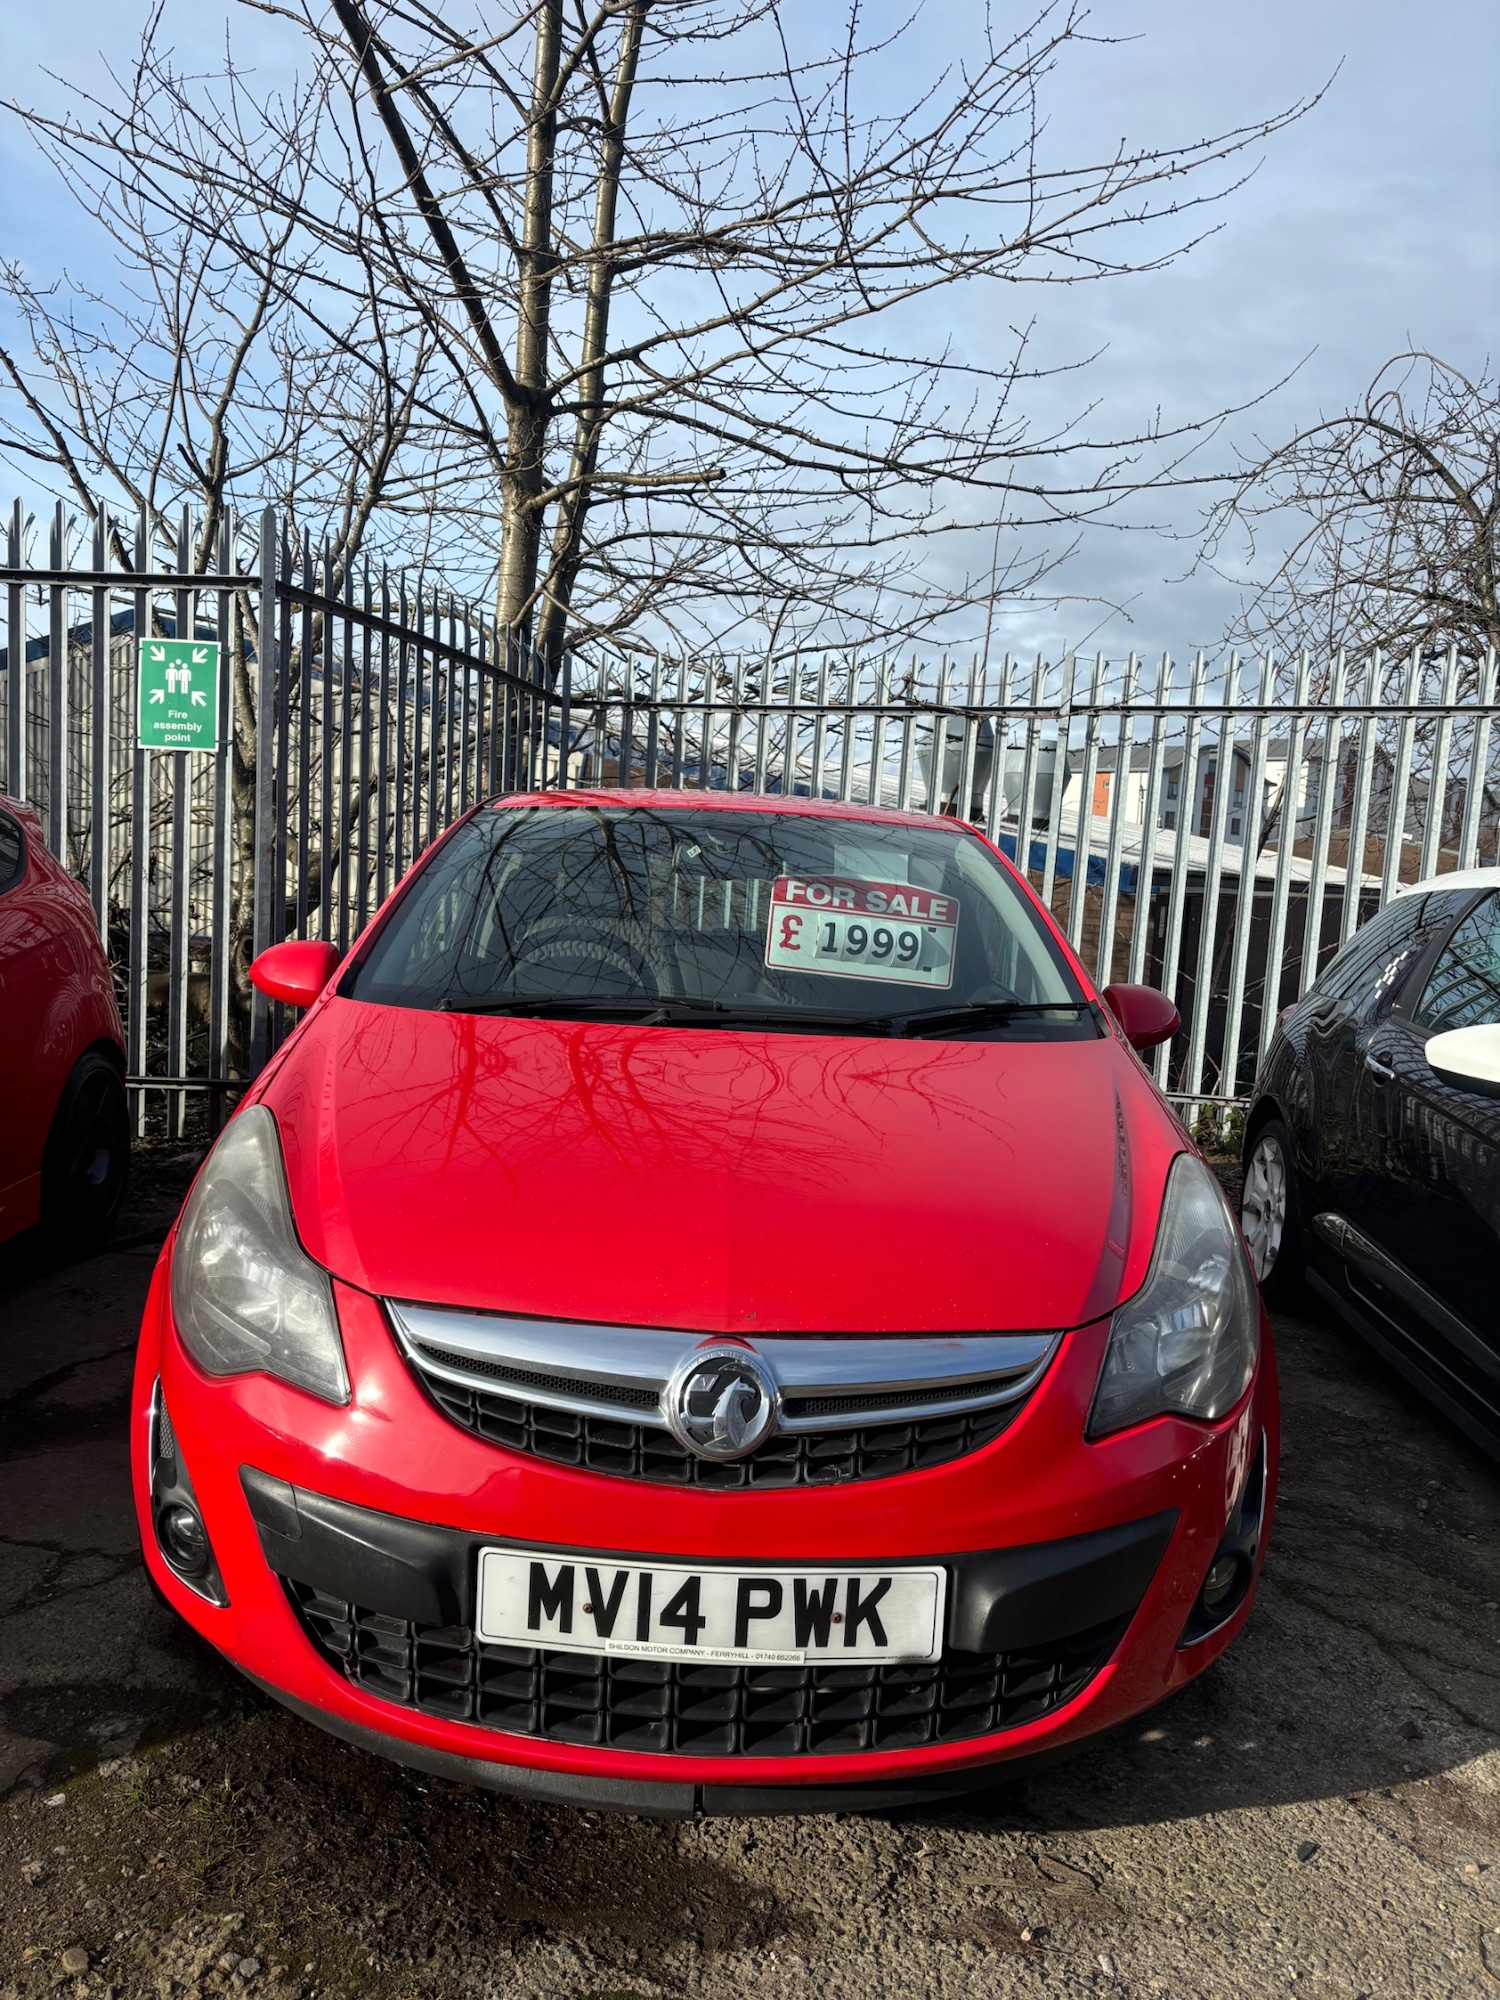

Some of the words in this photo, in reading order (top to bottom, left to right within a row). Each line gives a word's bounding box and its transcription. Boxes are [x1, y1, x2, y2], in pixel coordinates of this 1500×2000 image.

[168, 710, 188, 719] Fire
[153, 722, 202, 733] assembly
[164, 733, 191, 743] point
[785, 880, 856, 909] FOR
[865, 890, 949, 921] SALE
[779, 914, 803, 951] £
[821, 922, 919, 962] 1999
[527, 1562, 706, 1646] MV14
[734, 1577, 893, 1648] PWK
[608, 1643, 640, 1651] SHILDON
[641, 1645, 668, 1654] MOTOR
[669, 1647, 705, 1656] COMPANY
[711, 1650, 750, 1659] FERRYHILL
